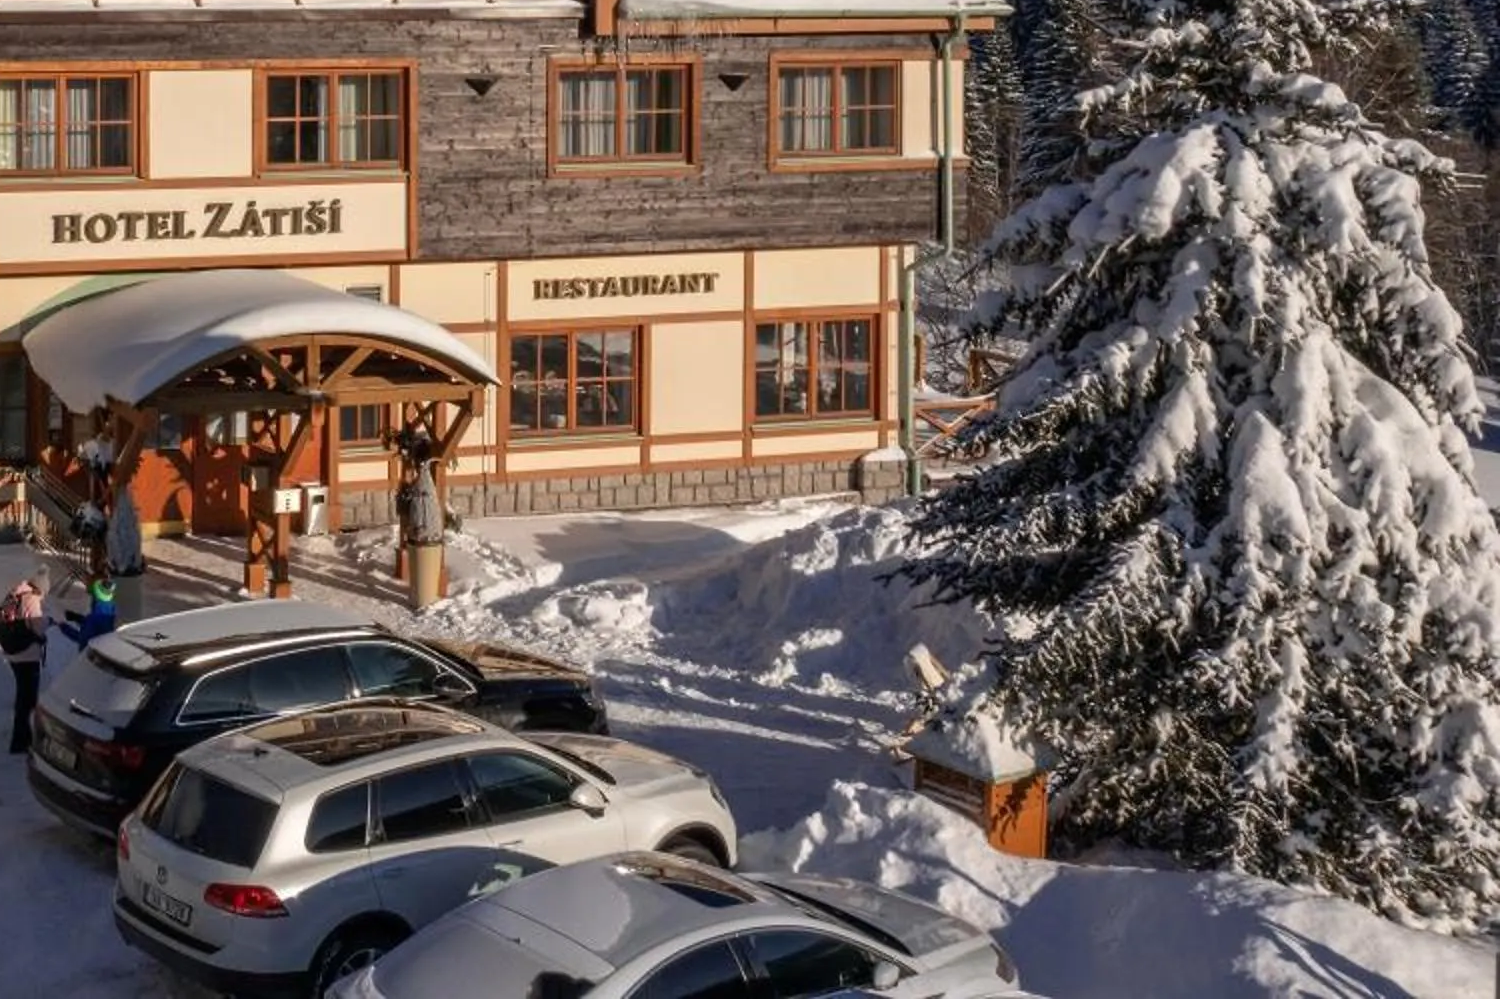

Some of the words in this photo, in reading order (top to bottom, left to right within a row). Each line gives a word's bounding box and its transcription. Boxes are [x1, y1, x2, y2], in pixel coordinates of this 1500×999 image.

[51, 209, 196, 244] HOTEL
[203, 198, 344, 239] ZÁTIŠÍ
[532, 272, 720, 300] RESTAURANT
